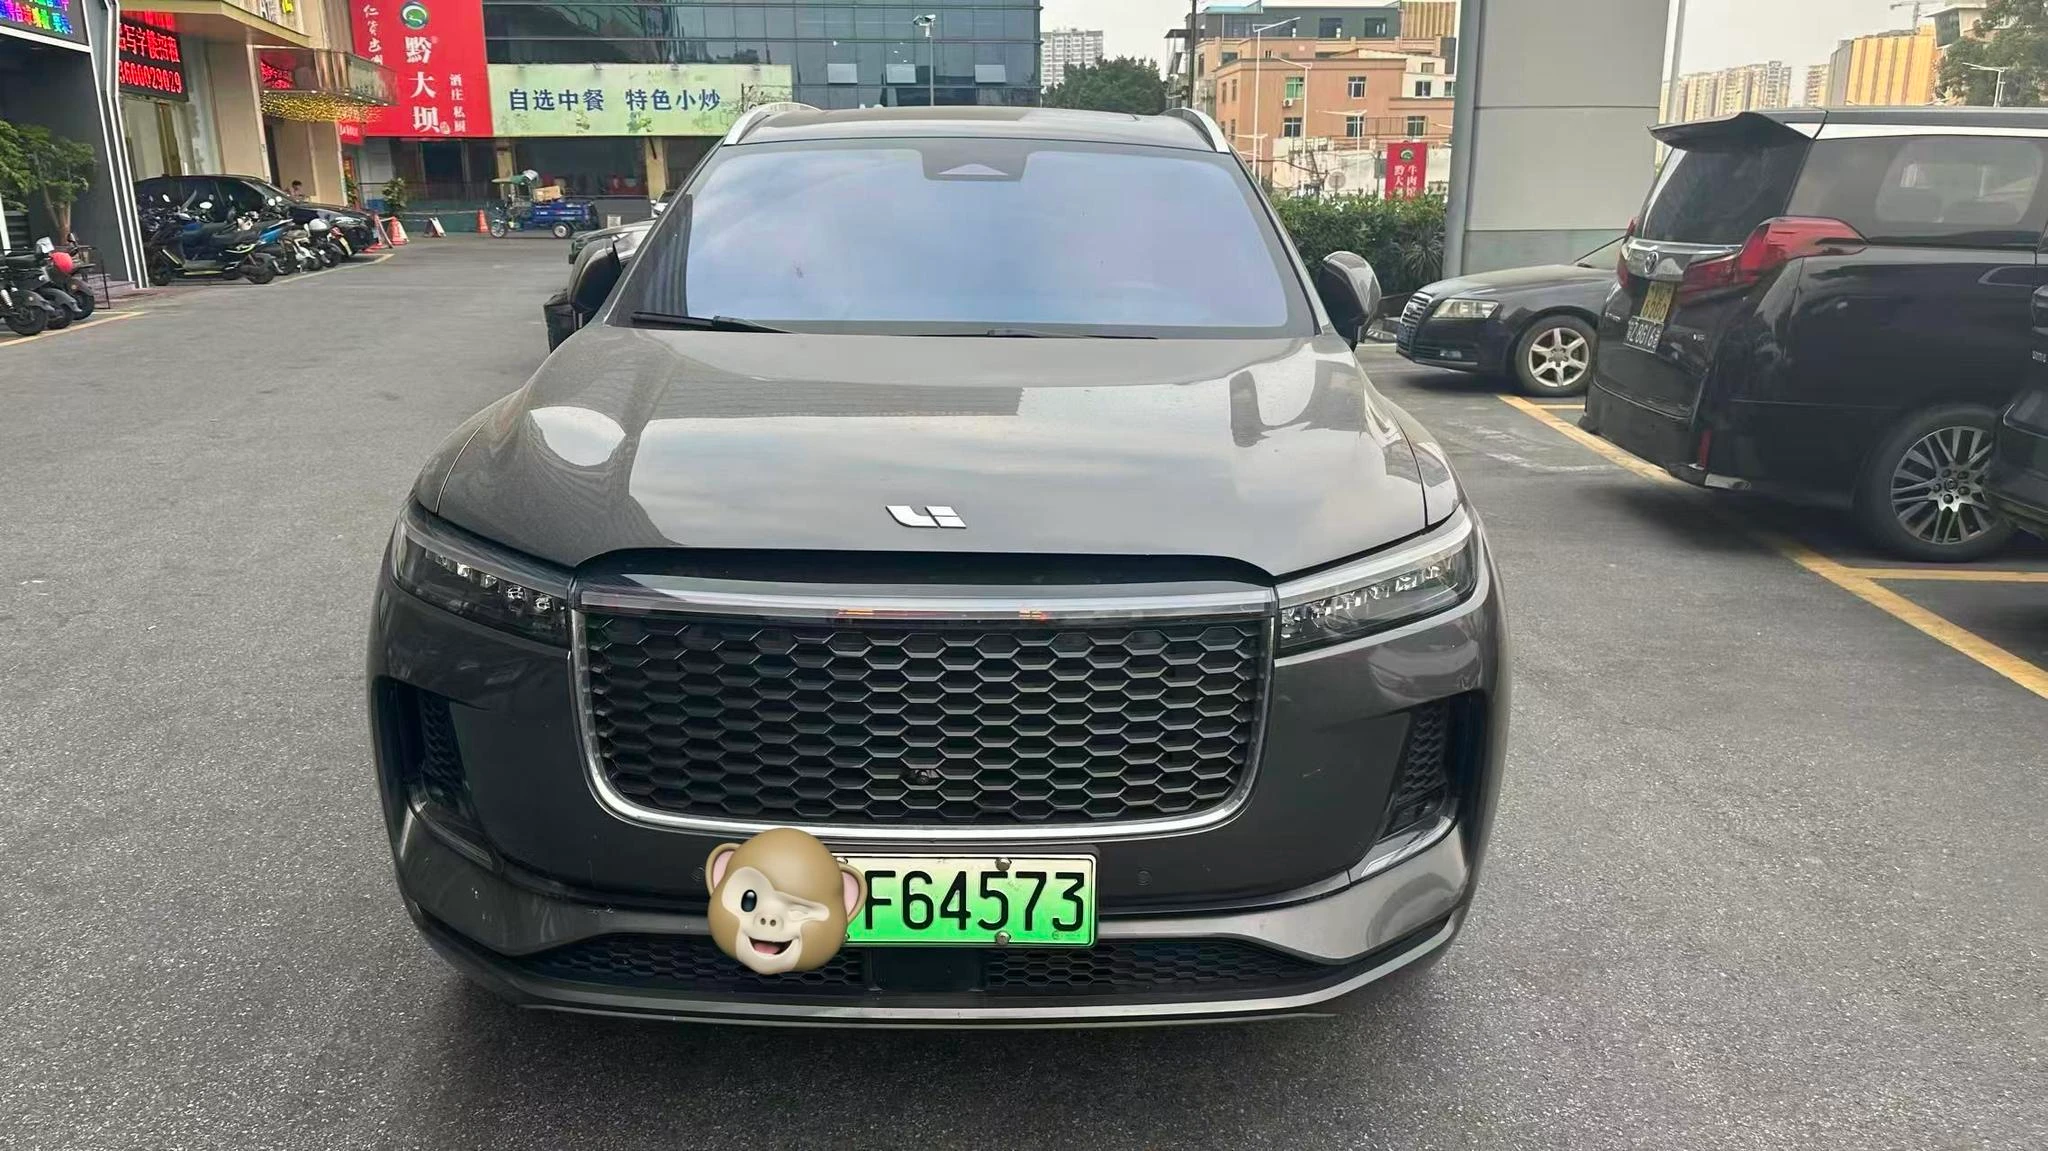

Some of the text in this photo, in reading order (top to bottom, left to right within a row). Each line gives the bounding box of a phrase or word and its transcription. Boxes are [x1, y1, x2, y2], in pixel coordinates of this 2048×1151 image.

[405, 36, 440, 133] 黔大坝
[509, 88, 721, 111] 自选中餐 特色小炒
[864, 870, 1085, 931] F64573
